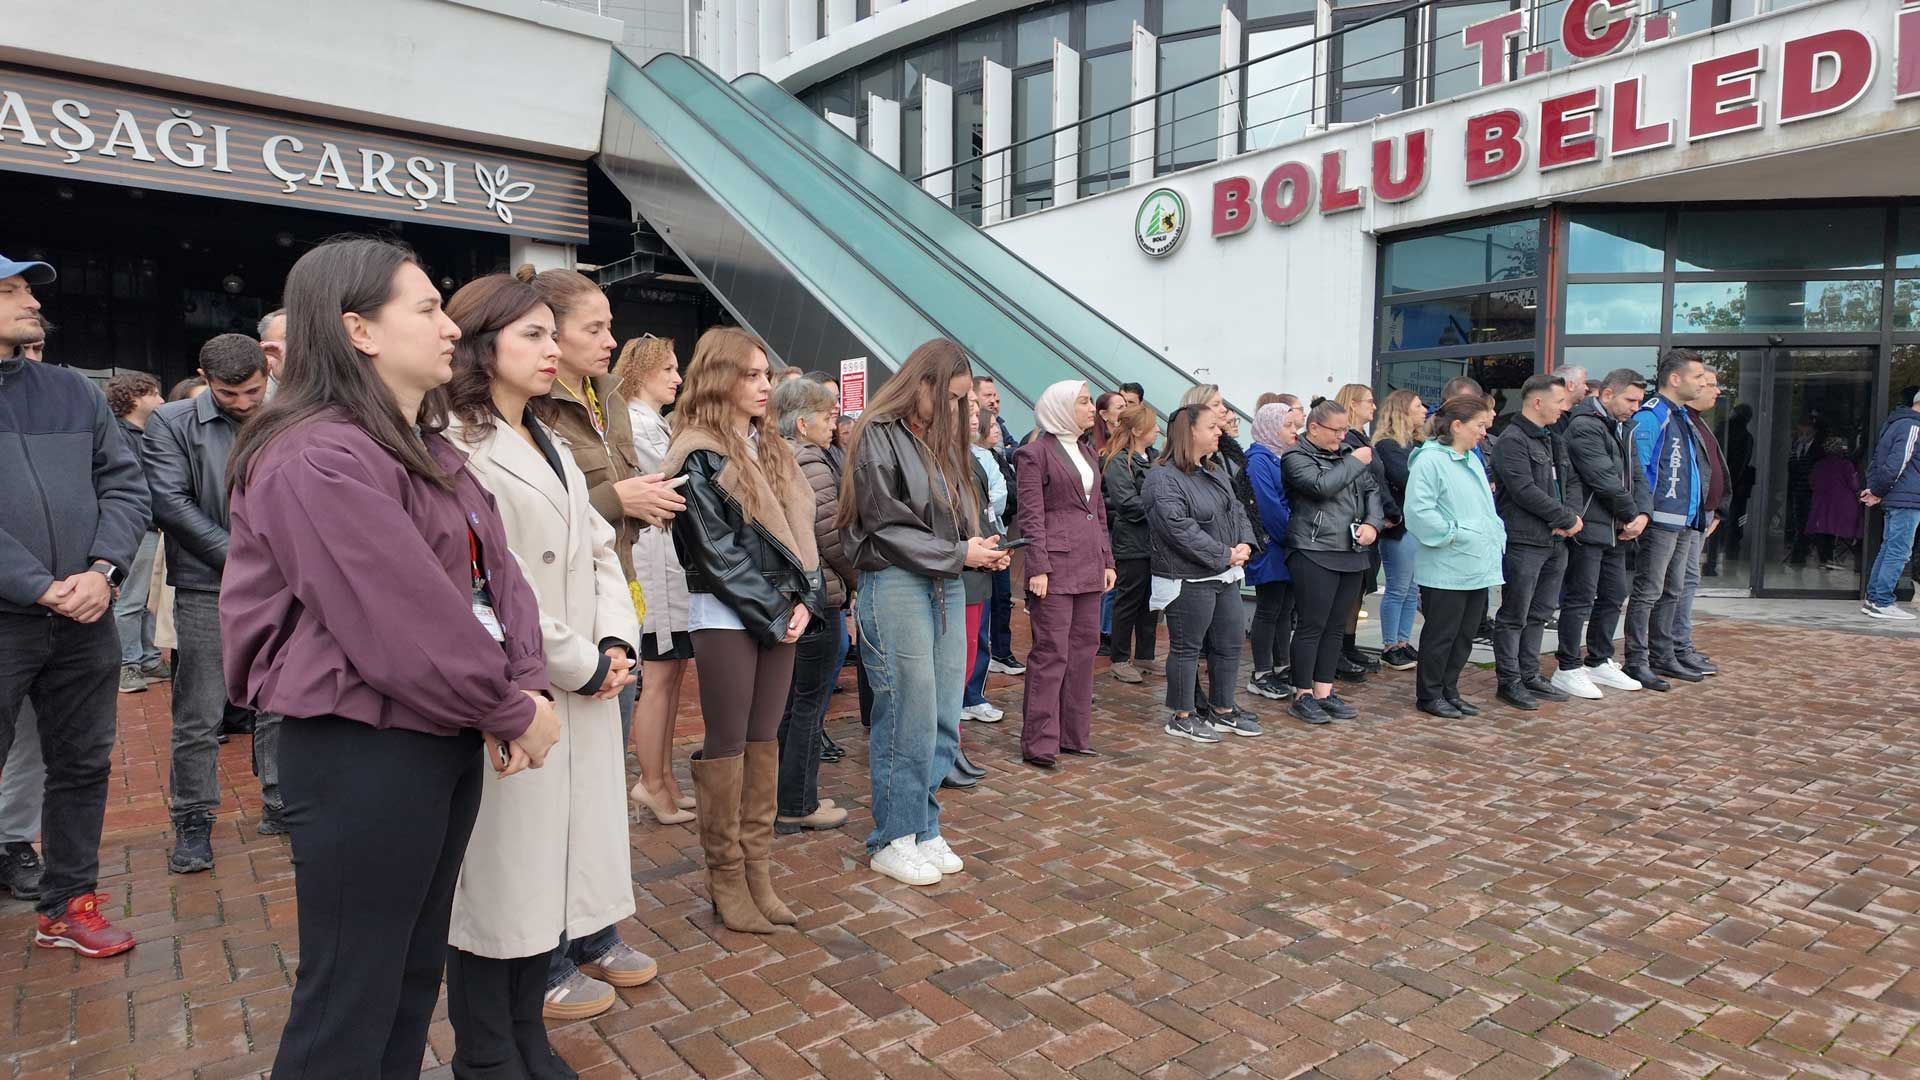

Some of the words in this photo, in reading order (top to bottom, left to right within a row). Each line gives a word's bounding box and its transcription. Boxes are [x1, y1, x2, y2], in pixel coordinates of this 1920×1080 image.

[1463, 0, 1677, 87] T.C.
[0, 91, 233, 173] AŞAĞI
[262, 135, 458, 210] ÇARŞI
[1212, 128, 1432, 238] BOLU
[1665, 437, 1682, 499] ZABITA
